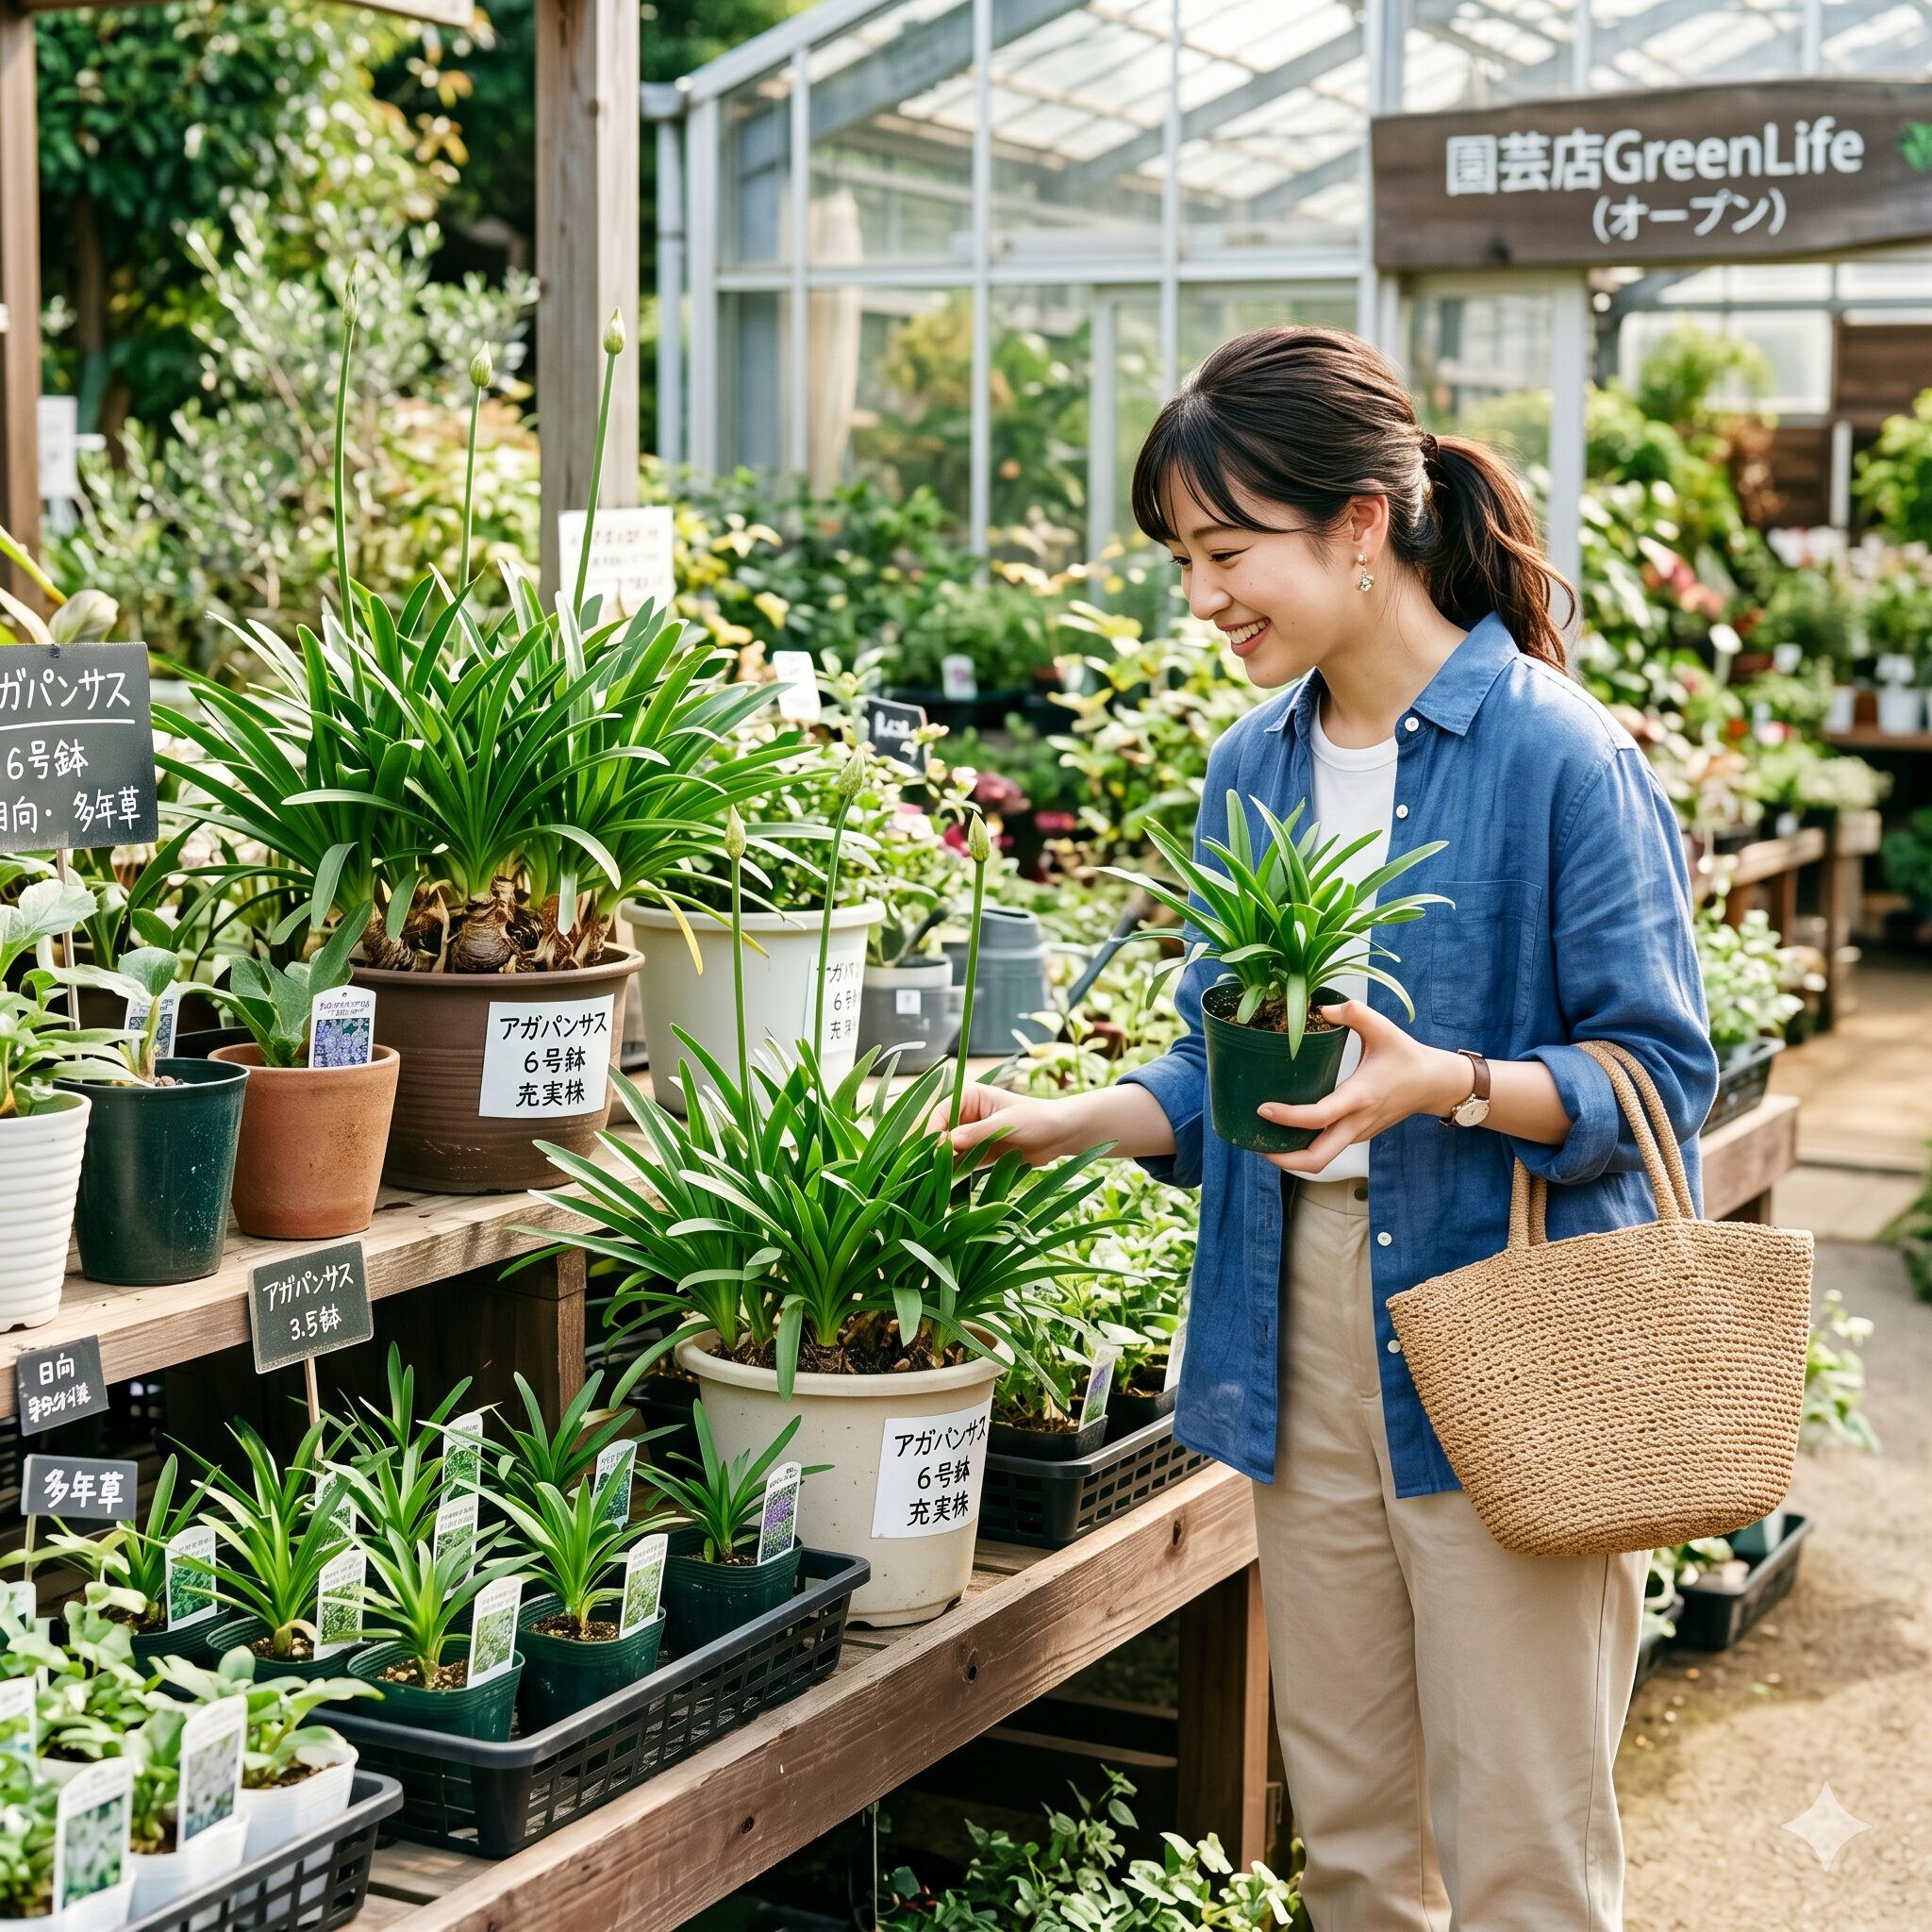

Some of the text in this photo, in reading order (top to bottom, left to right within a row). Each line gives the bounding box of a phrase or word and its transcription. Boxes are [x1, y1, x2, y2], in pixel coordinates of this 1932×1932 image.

[1445, 114, 1866, 196] 園芸店GreenLife
[1592, 187, 1788, 243] (オープン)
[7, 738, 89, 780] 6号鉢
[73, 785, 142, 833] 多年草
[500, 1011, 608, 1041] アガパンサス
[524, 1045, 587, 1074] 6号鉢
[262, 1262, 355, 1312] アガパンサス
[894, 1415, 986, 1457] アガパンサス
[43, 1468, 125, 1514] 多年草
[917, 1455, 971, 1490] 6号鉢
[906, 1490, 969, 1526] 充実株
